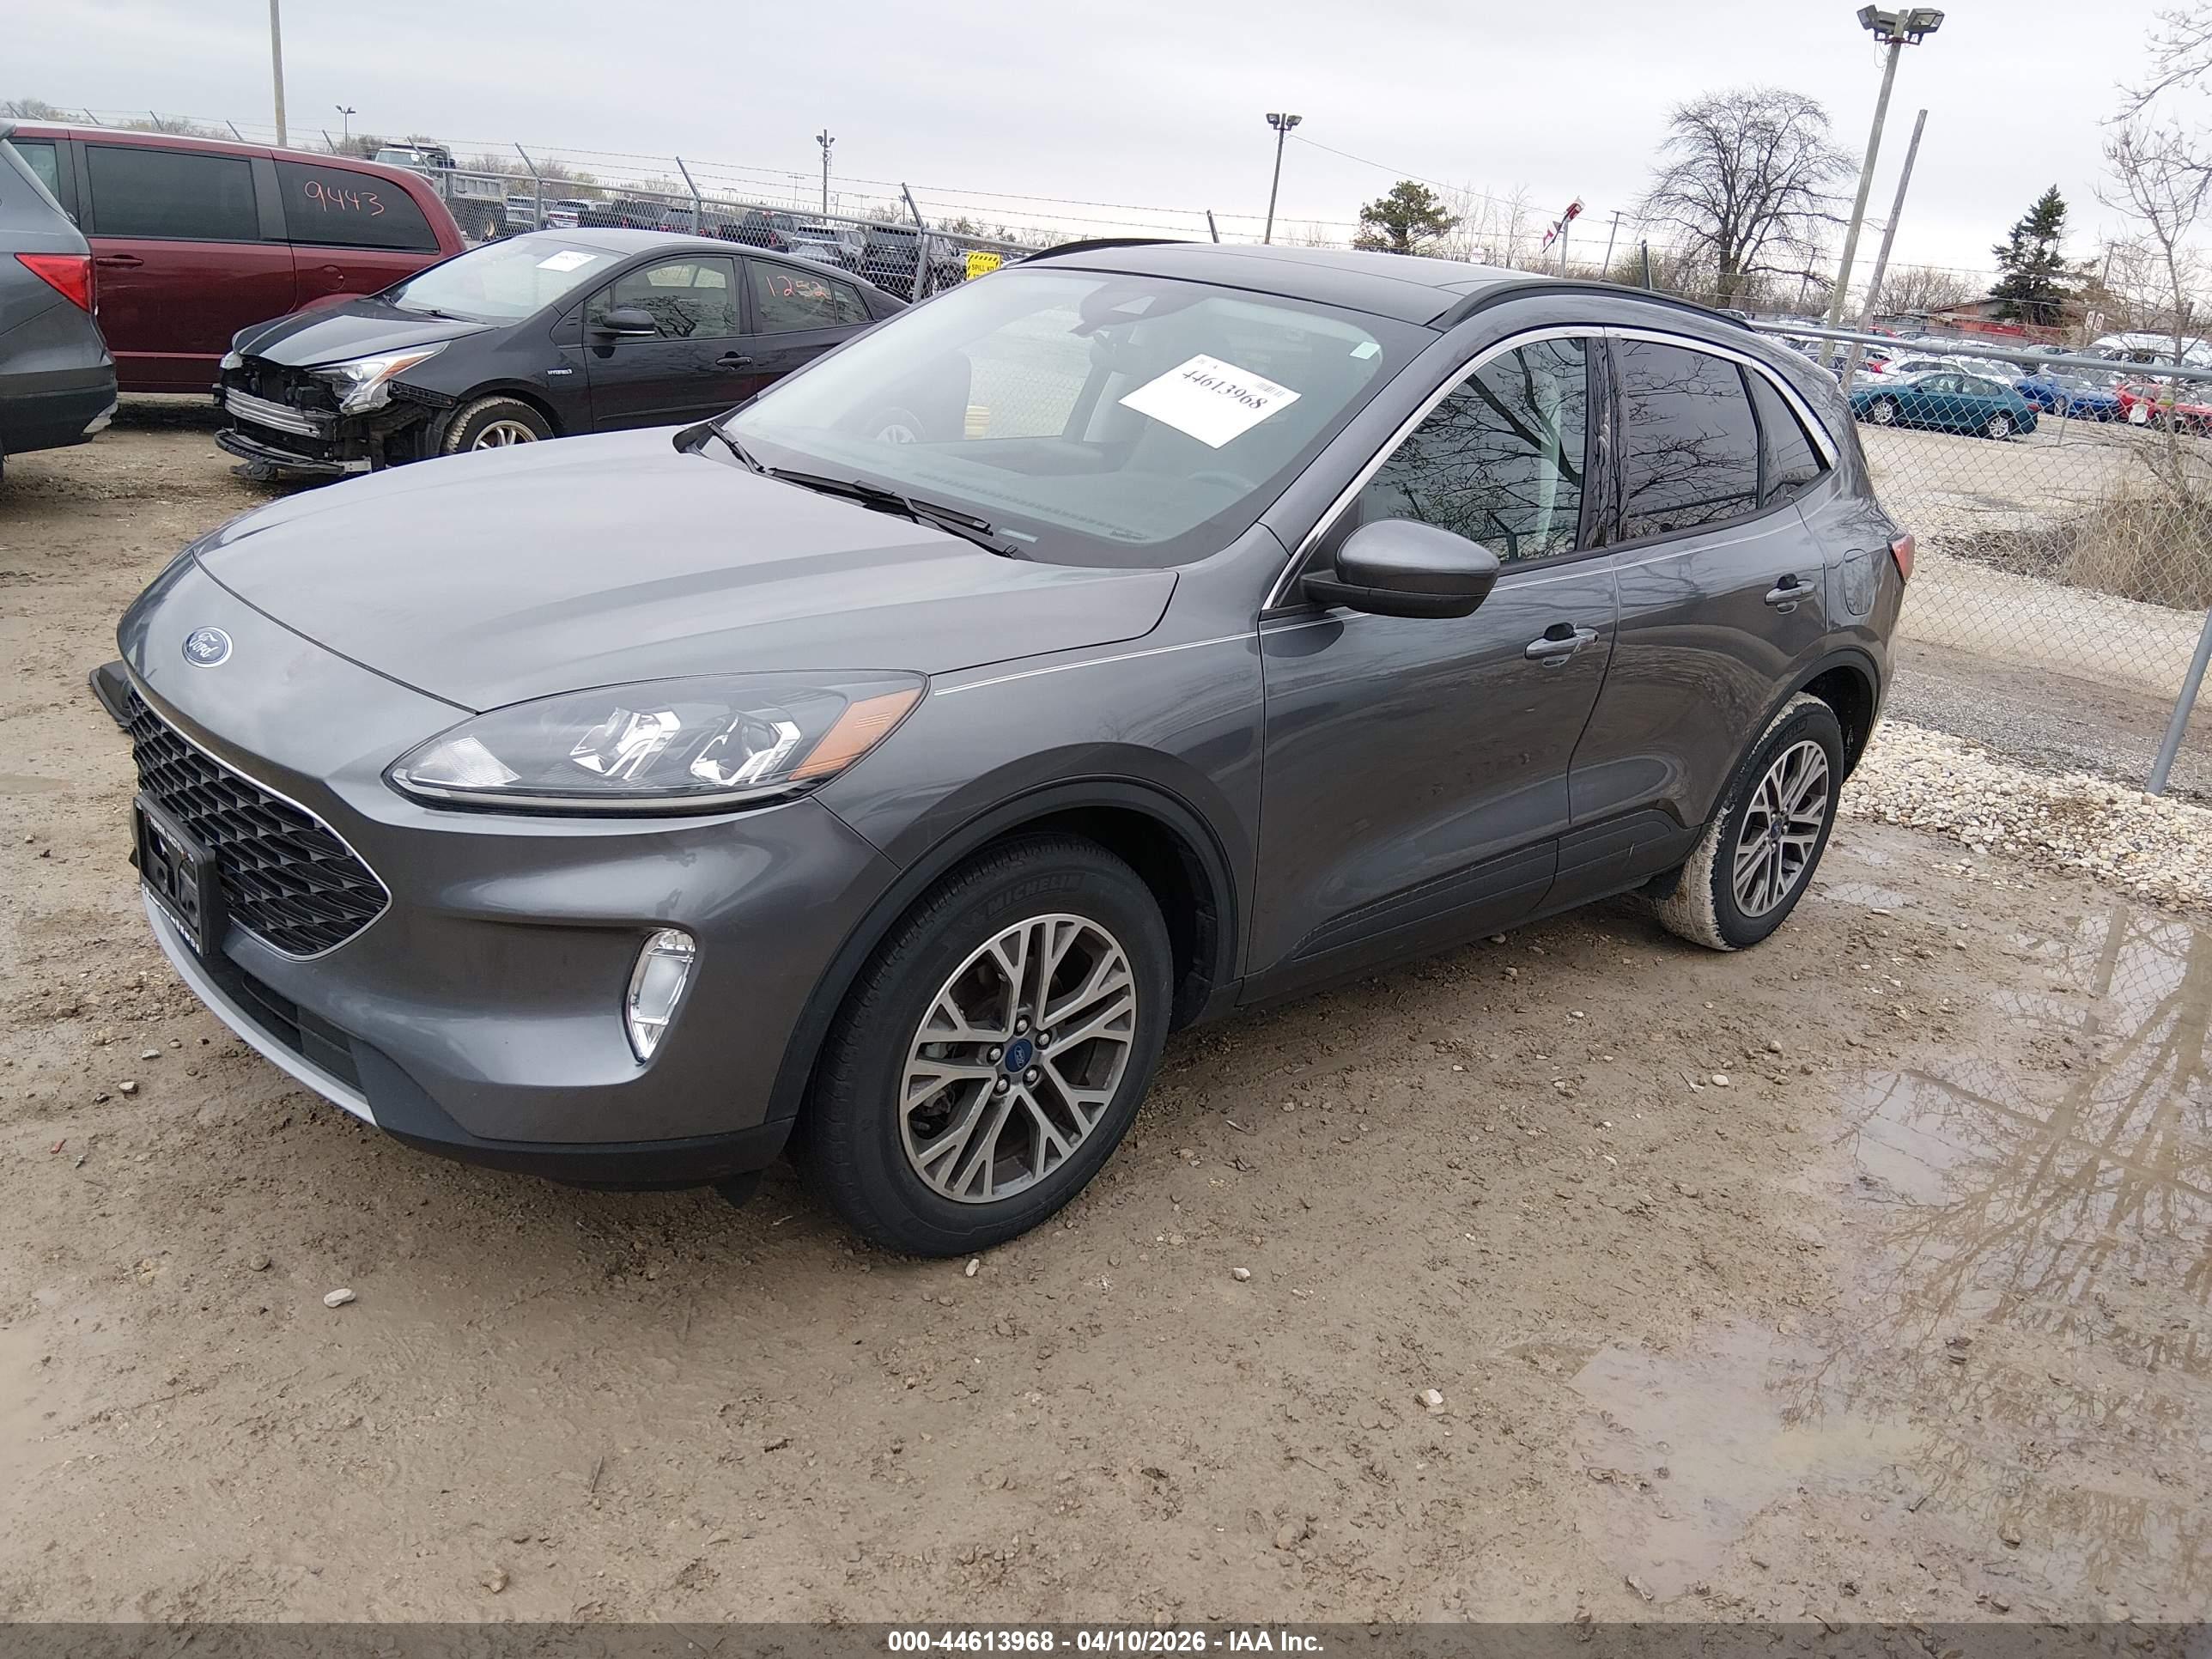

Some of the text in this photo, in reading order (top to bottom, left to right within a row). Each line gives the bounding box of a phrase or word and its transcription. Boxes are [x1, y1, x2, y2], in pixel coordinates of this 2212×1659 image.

[305, 180, 385, 216] 9443
[1182, 370, 1268, 409] 44613968
[189, 632, 219, 658] Ford
[988, 874, 1085, 916] MICHELIN
